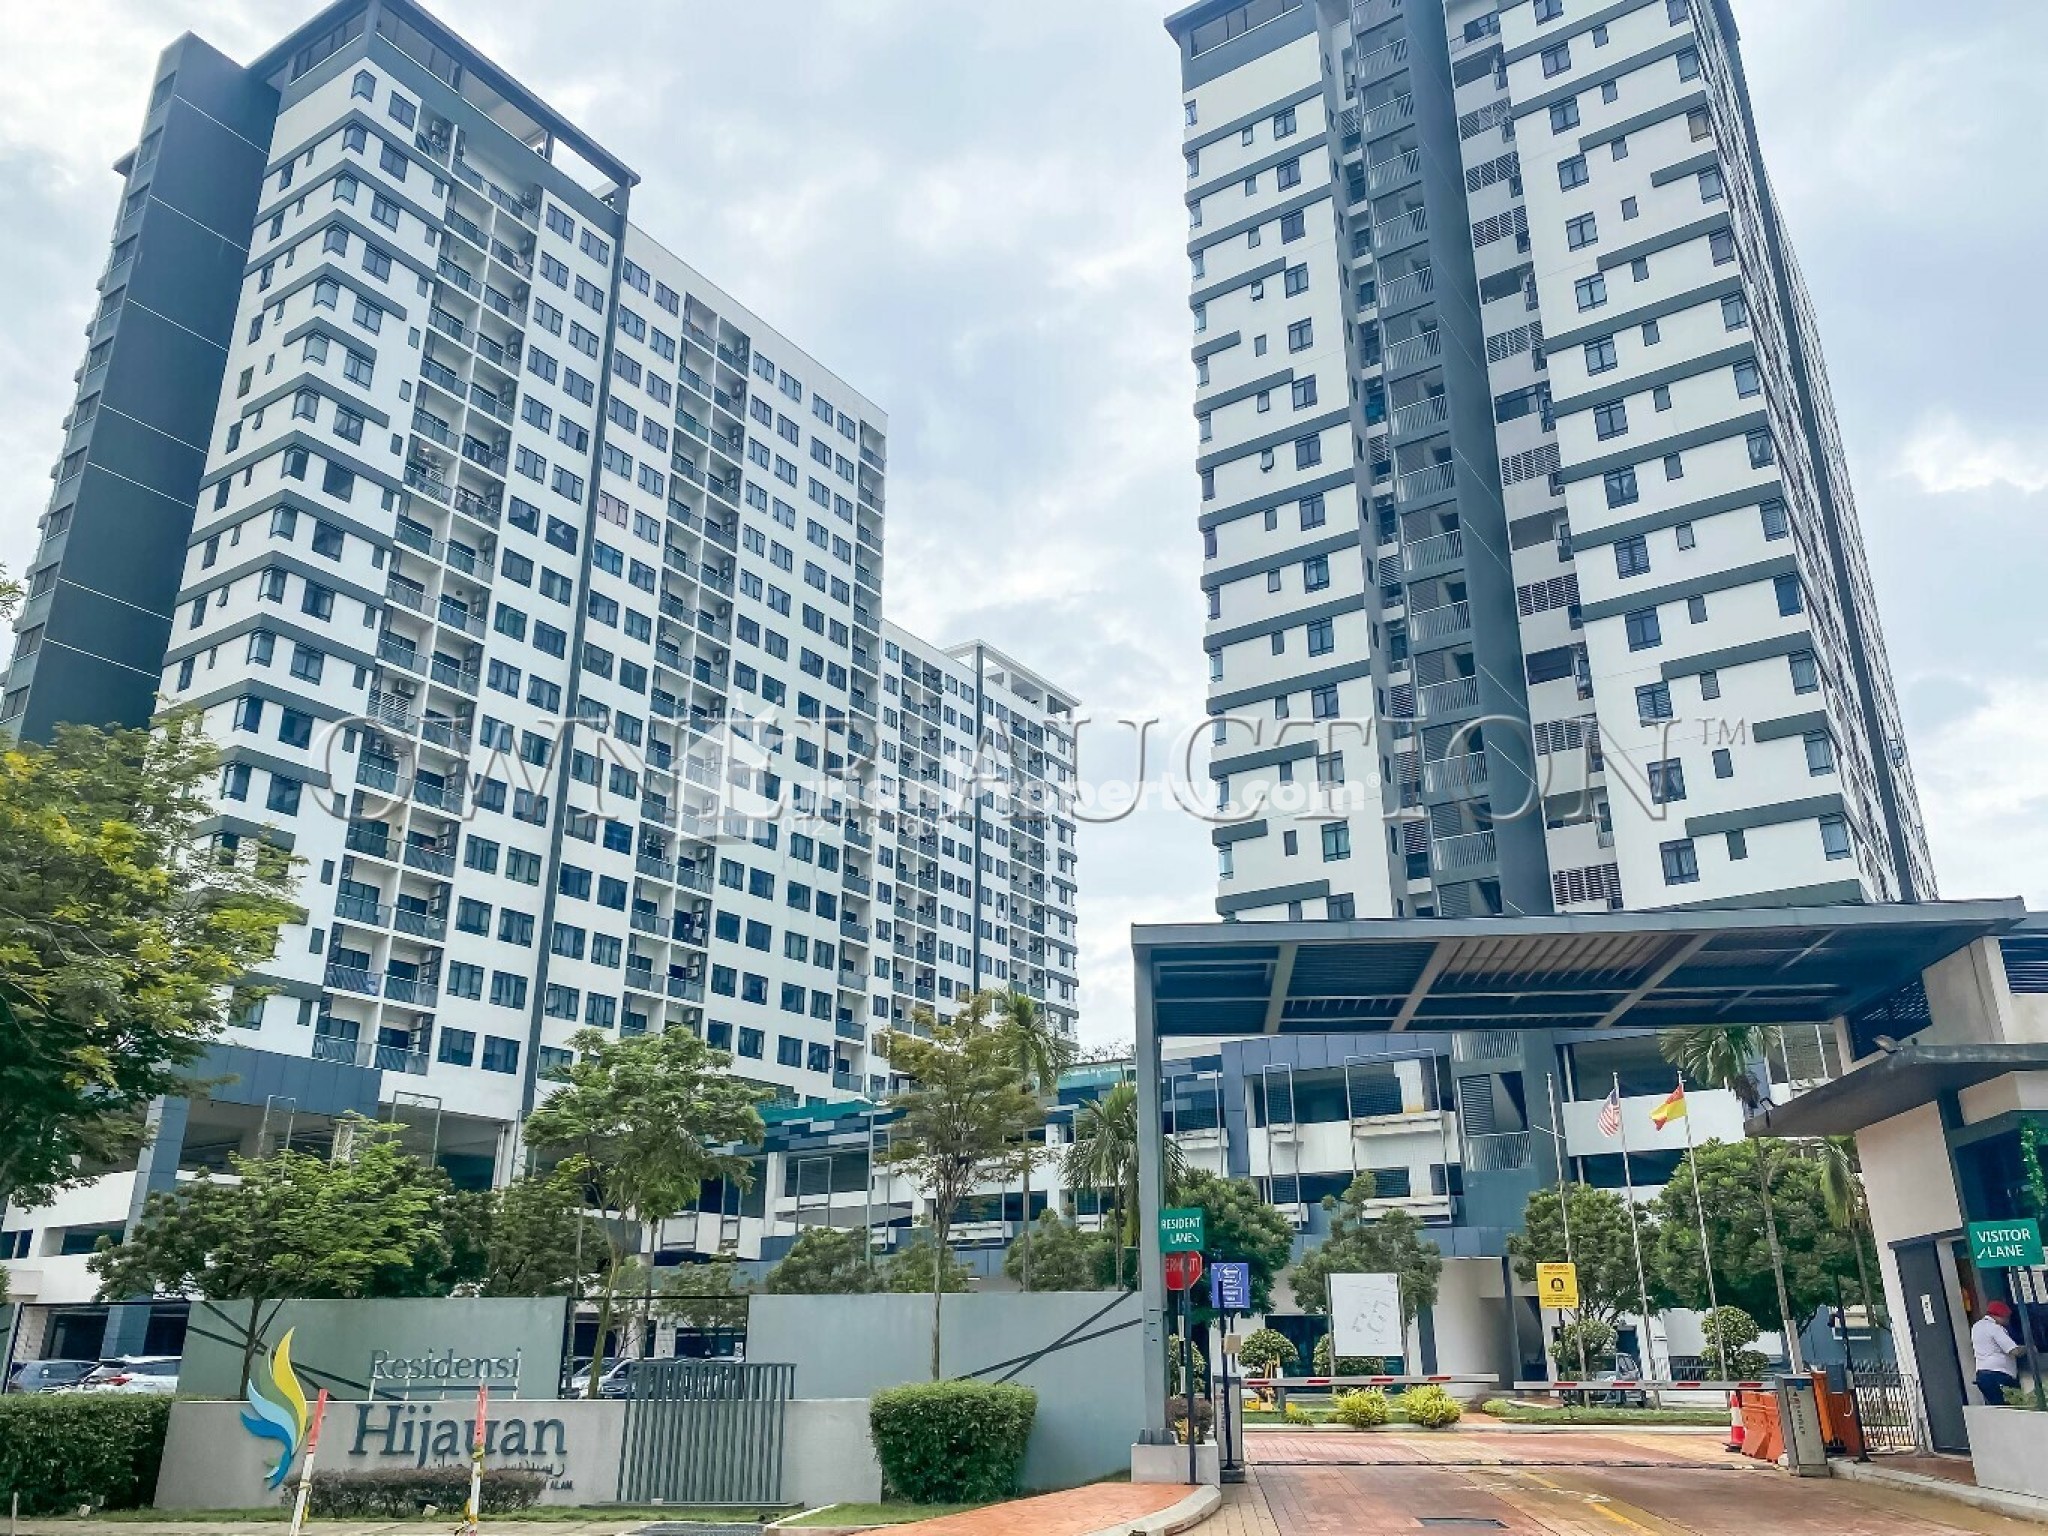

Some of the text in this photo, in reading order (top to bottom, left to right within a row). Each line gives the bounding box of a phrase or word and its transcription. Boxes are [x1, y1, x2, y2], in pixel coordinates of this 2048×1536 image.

[1161, 1217, 1201, 1230] RESIDENT
[1169, 1232, 1192, 1244] LANE
[1977, 1227, 2031, 1243] VISITOR
[1987, 1244, 2025, 1258] LANE
[370, 1347, 522, 1379] Residensi
[348, 1403, 568, 1469] Hijauan
